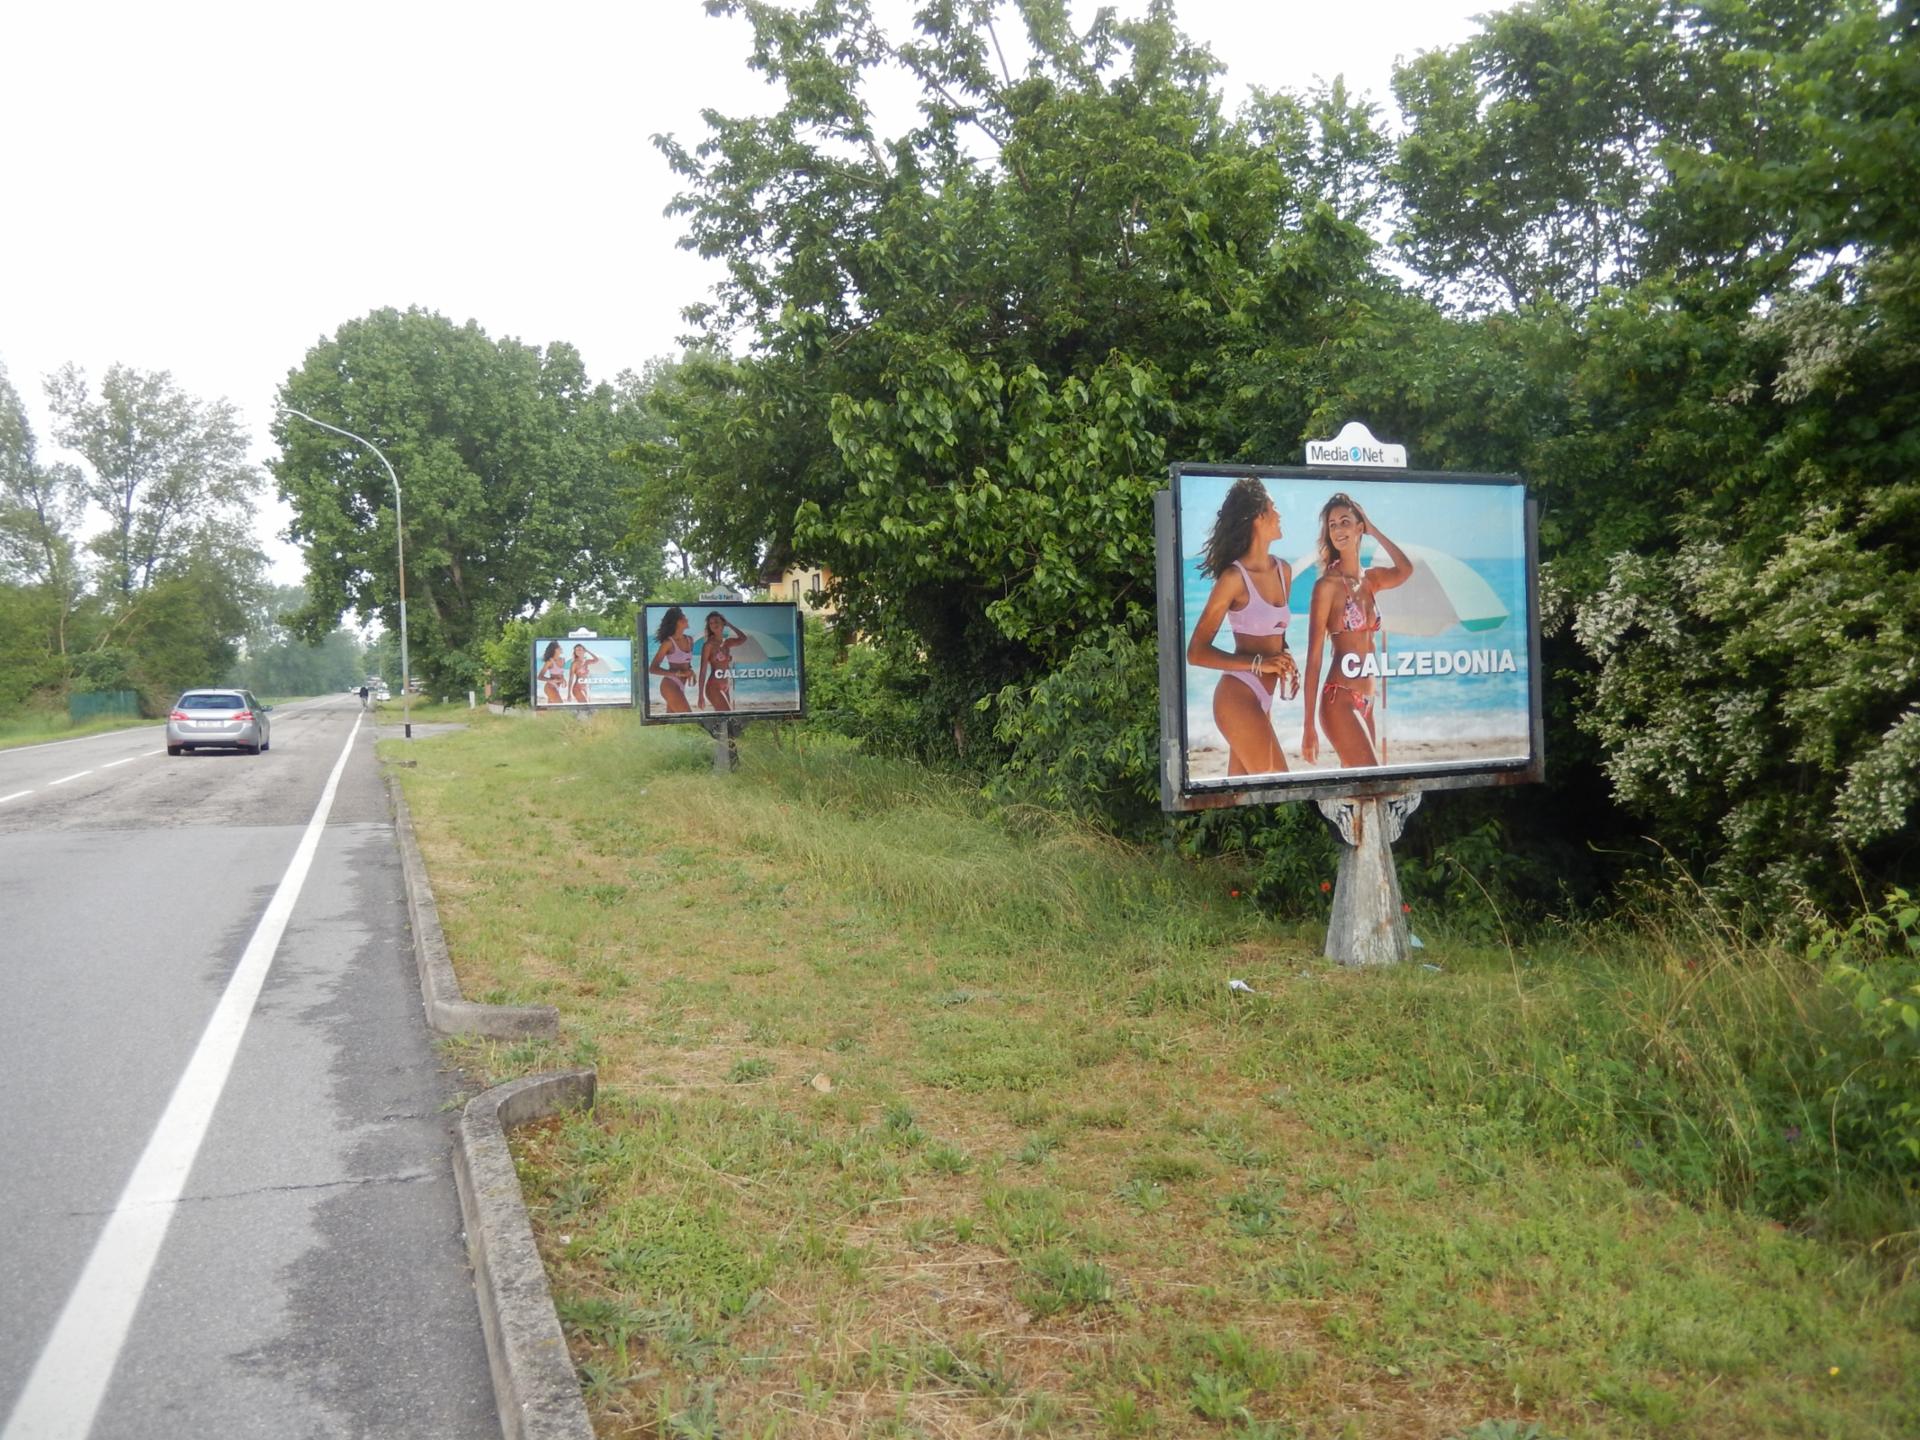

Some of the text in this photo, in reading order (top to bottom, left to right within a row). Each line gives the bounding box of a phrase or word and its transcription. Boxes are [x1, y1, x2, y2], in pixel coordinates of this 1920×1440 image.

[1311, 446, 1349, 461] Media
[1362, 448, 1384, 462] Net
[1341, 649, 1517, 678] CALZEDONIA
[714, 667, 795, 679] CALZEDONIA
